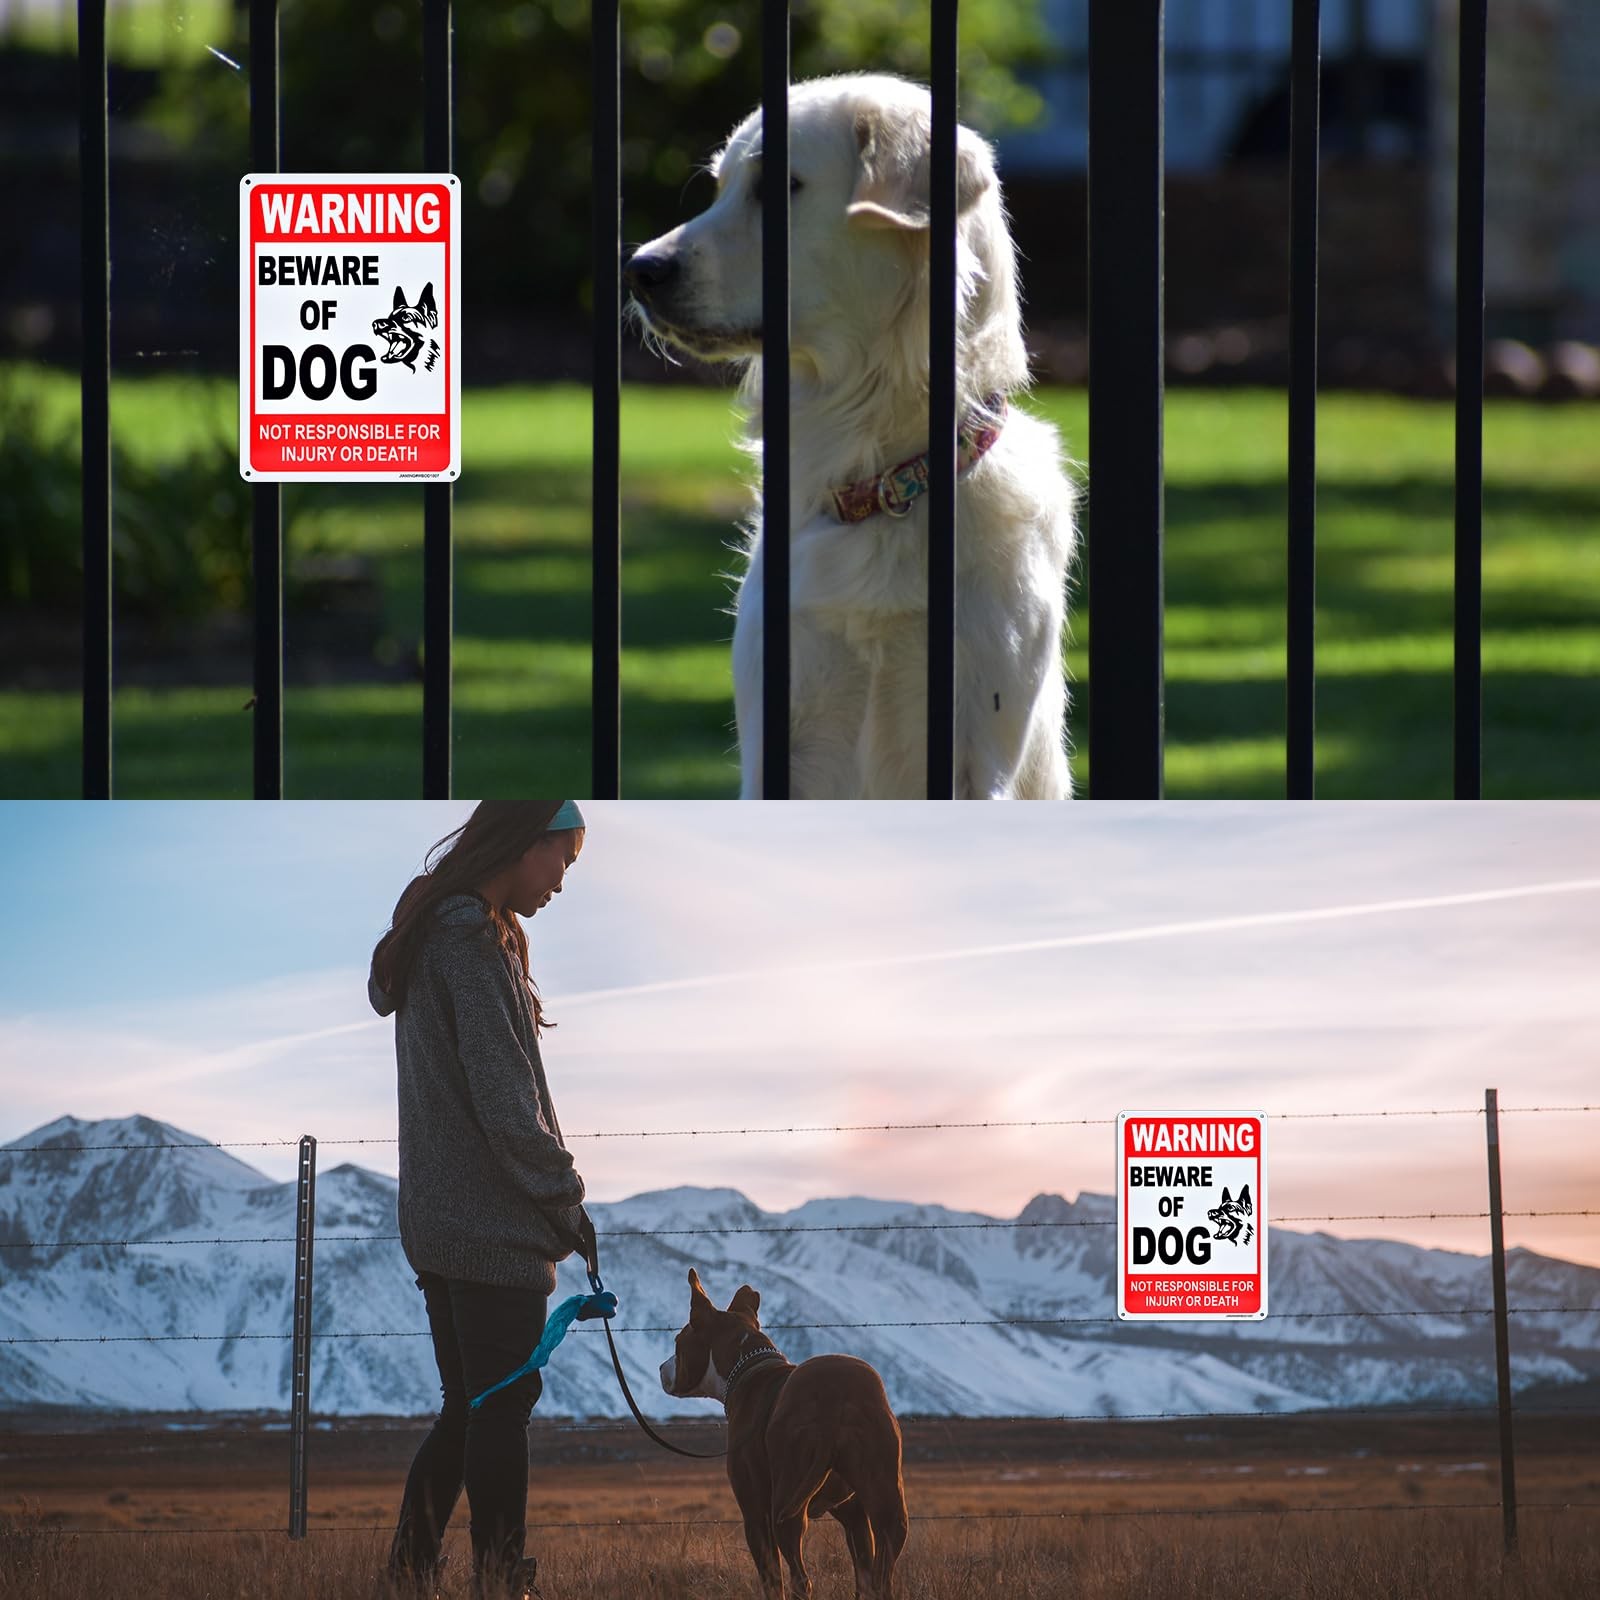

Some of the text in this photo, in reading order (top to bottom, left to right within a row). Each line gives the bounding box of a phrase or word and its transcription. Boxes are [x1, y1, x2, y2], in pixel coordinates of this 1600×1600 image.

[260, 192, 441, 235] WARNING
[258, 255, 379, 286] BEWARE
[299, 300, 337, 331] OF
[262, 343, 378, 402] DOG
[259, 424, 440, 440] NOT RESPONSIBLE FOR
[281, 446, 418, 462] INJURY OR DEATH
[1132, 1123, 1254, 1152] WARNING
[1130, 1166, 1213, 1187] BEWARE
[1158, 1196, 1184, 1217] OF
[1133, 1226, 1211, 1266] DOG
[1130, 1280, 1254, 1292] NOT RESPONSIBLE FOR
[1145, 1295, 1239, 1307] INJURY OR DEATH
